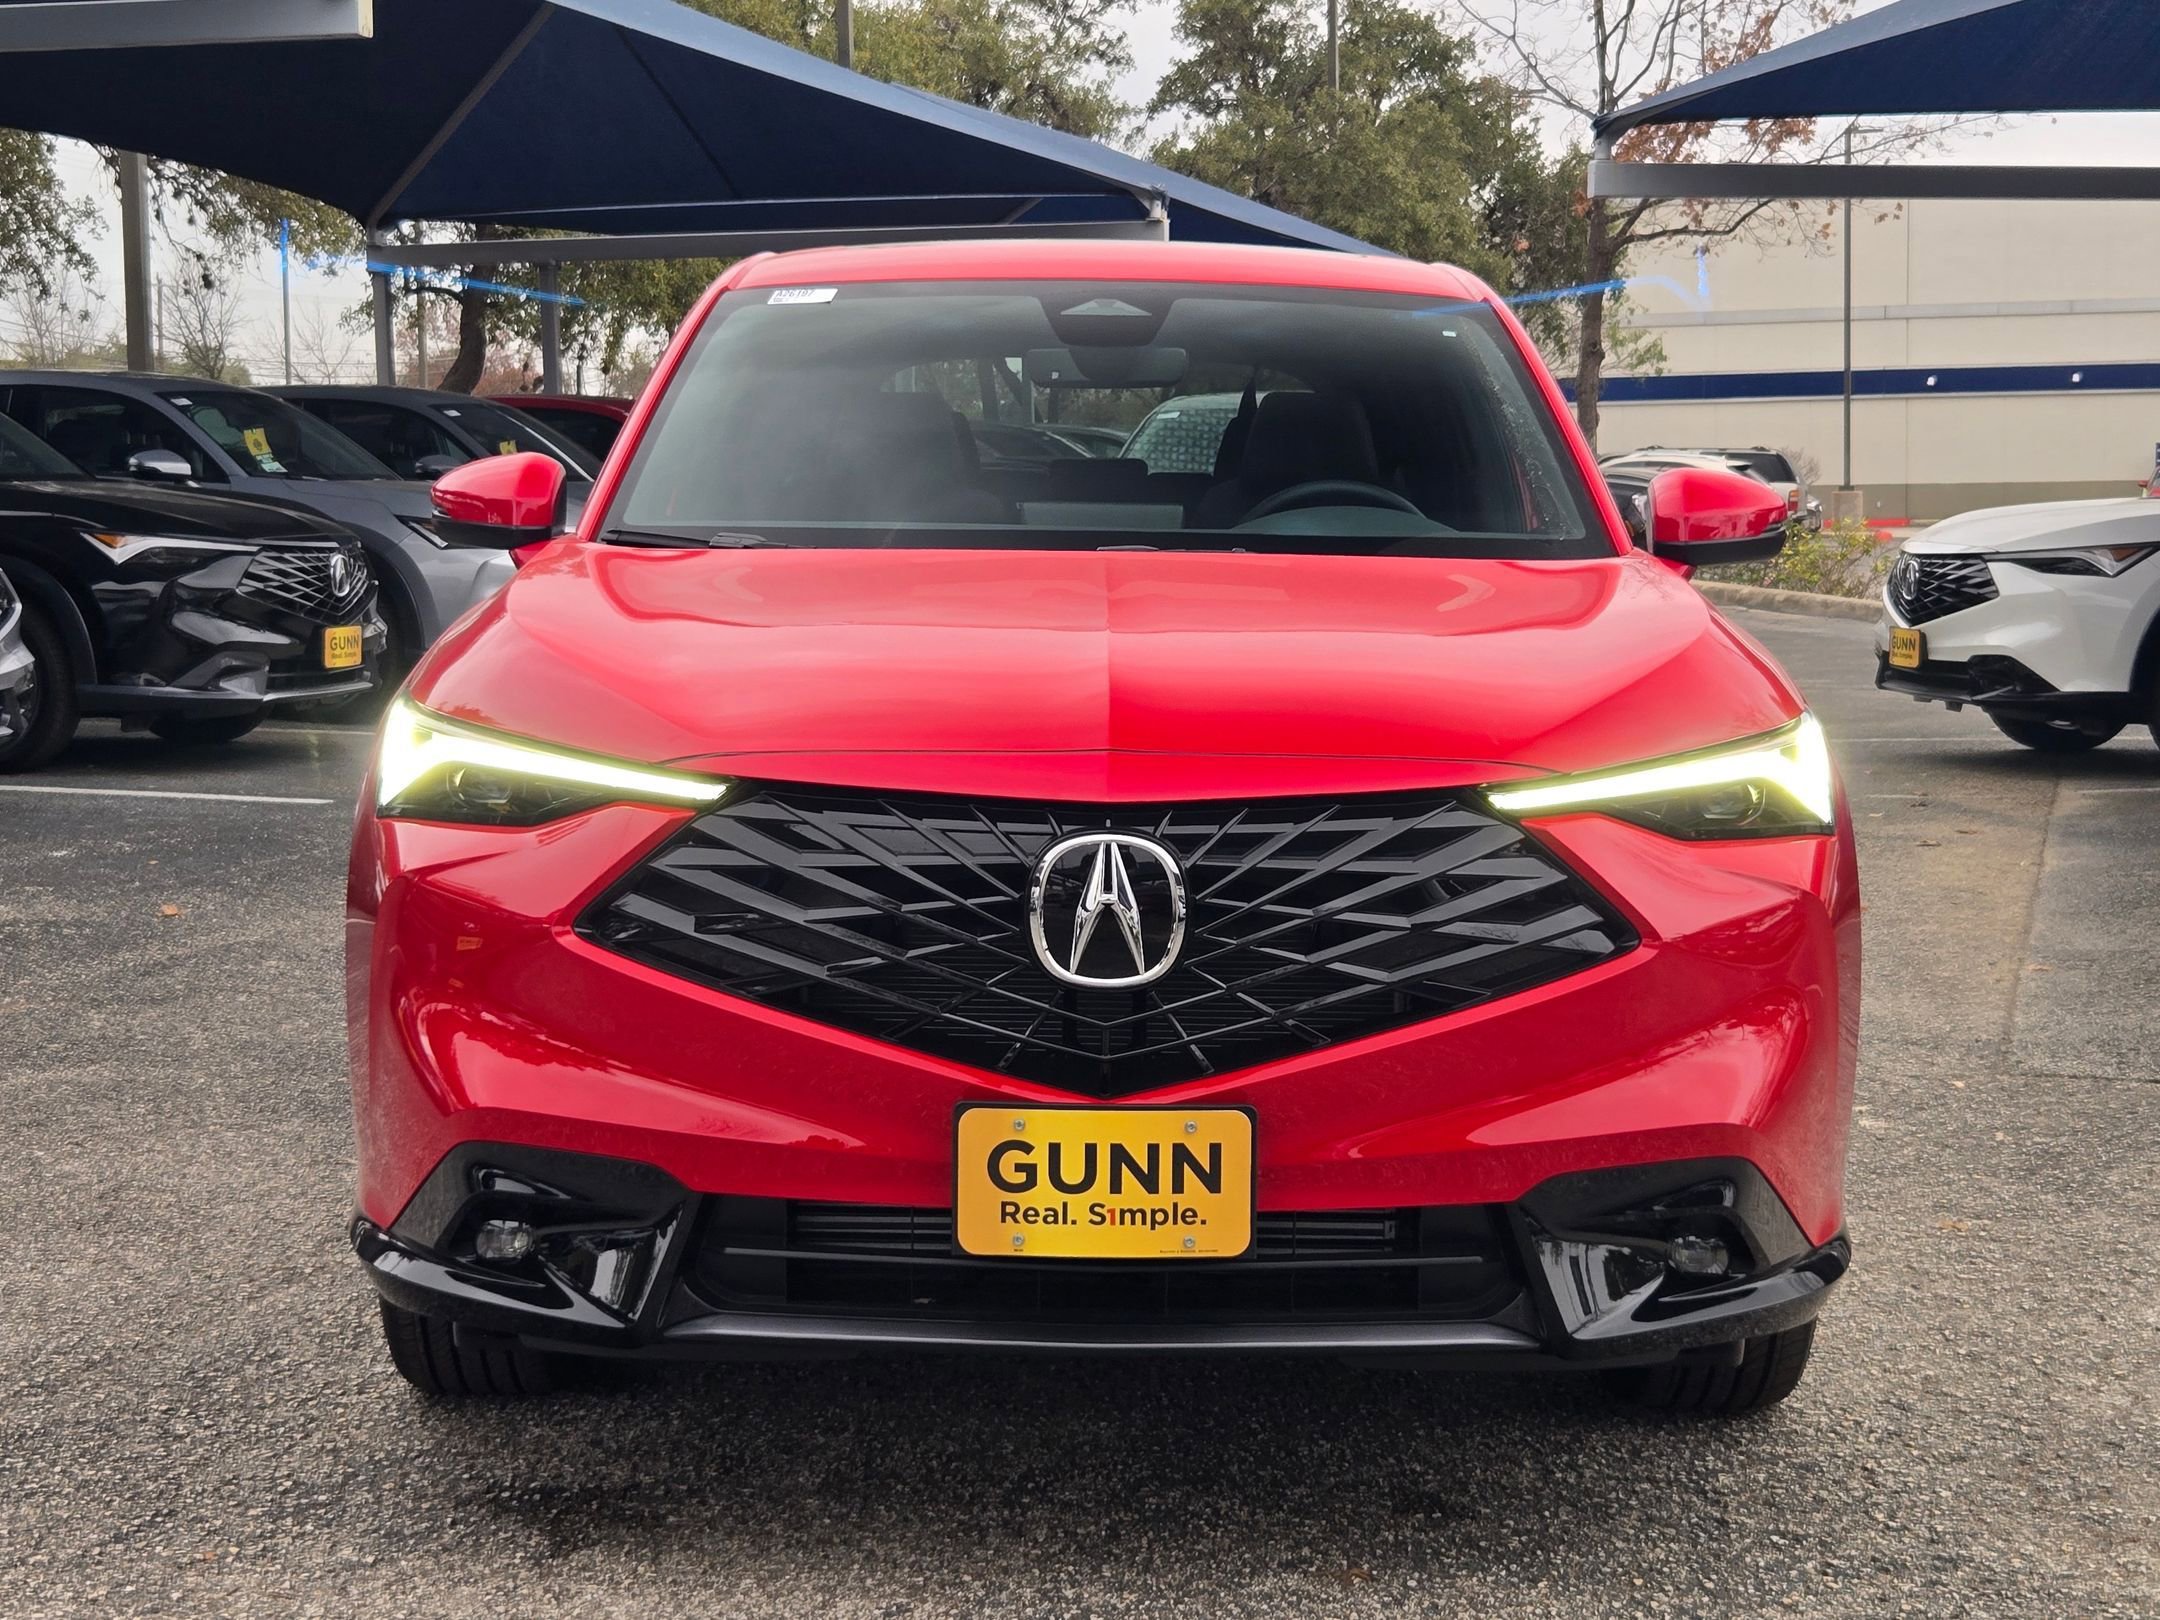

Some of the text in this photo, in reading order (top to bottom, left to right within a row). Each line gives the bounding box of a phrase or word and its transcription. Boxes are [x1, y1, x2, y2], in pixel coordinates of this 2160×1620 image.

[330, 635, 359, 651] GUNN
[1891, 635, 1916, 652] GUNN
[987, 1139, 1222, 1194] GUNN
[1000, 1201, 1077, 1226] Real.
